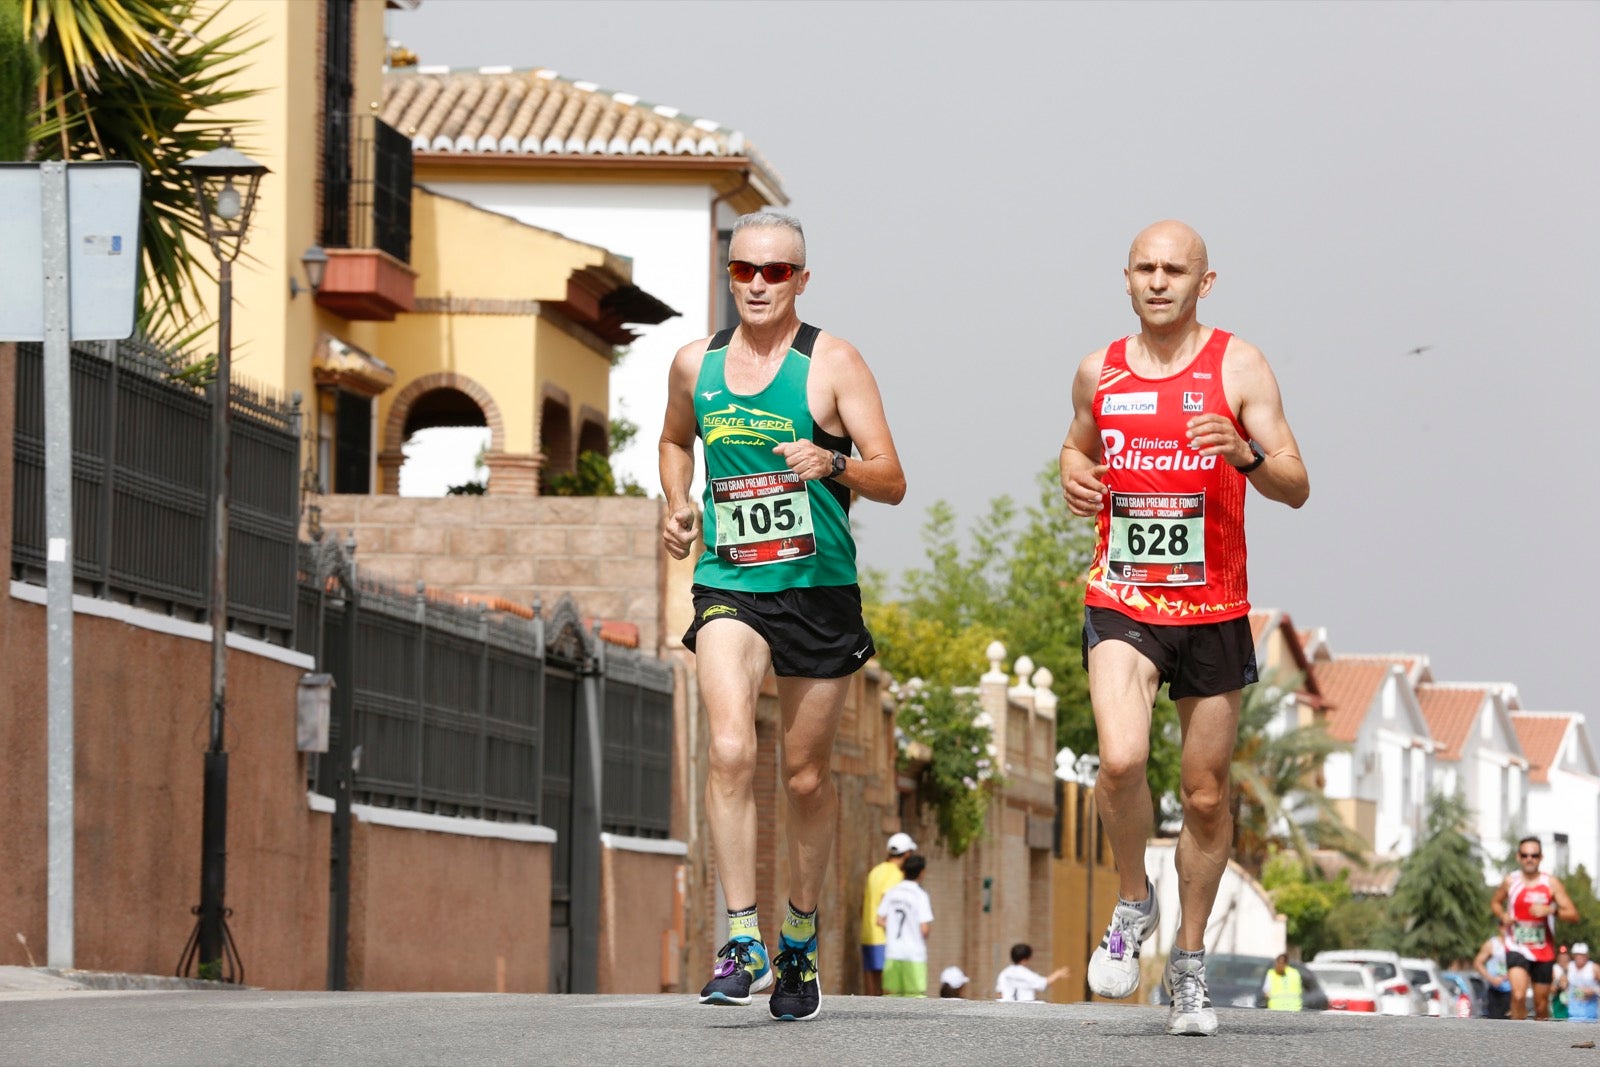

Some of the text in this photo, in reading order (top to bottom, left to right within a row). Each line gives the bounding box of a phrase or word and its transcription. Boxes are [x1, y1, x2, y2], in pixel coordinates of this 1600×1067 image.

[750, 418, 793, 429] VERDE
[721, 436, 766, 446] Granada
[1130, 437, 1179, 450] Clínicas
[728, 480, 745, 492] GRAN
[745, 476, 768, 489] PREMIO
[769, 475, 778, 485] DE
[778, 473, 800, 484] FONDO
[1128, 497, 1145, 508] GRAN
[1146, 497, 1169, 509] PREMIO
[1169, 497, 1178, 509] DE
[1179, 497, 1199, 508] FONDO
[731, 498, 796, 538] 105
[1127, 523, 1189, 556] 628
[895, 909, 907, 940] 7
